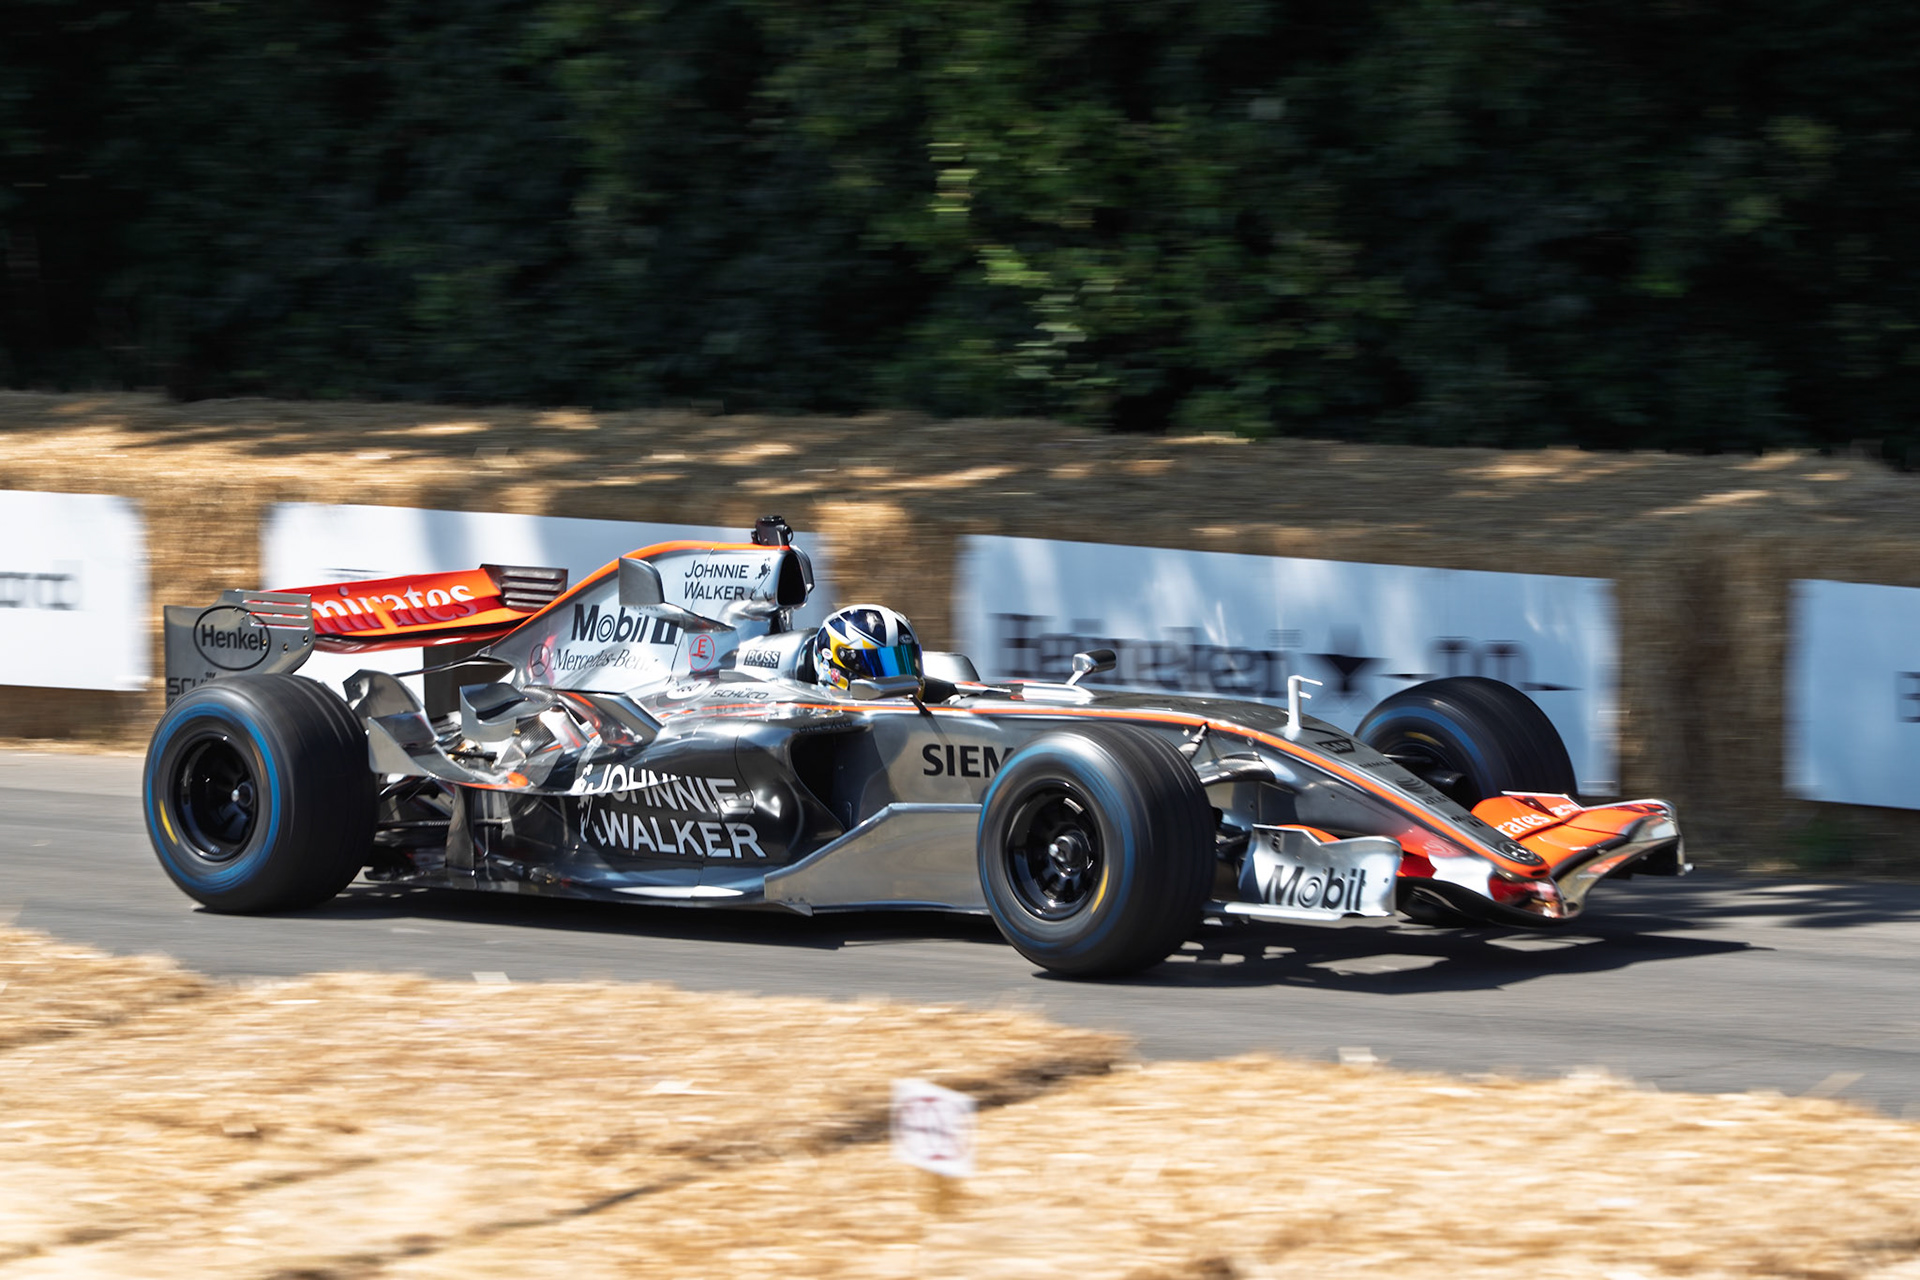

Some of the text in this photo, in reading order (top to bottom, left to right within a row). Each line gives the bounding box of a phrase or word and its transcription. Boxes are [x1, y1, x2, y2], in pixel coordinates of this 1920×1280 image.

[684, 560, 749, 579] JOHNNIE
[684, 582, 745, 601] WALKER
[311, 585, 478, 634] mirates
[571, 603, 650, 643] Mobil
[201, 624, 263, 651] Henkel
[553, 648, 651, 672] Mercedes-Ben
[747, 651, 779, 664] BOSS
[922, 744, 1015, 778] SIEM
[595, 764, 755, 815] JOHNNIE
[600, 808, 767, 859] WALKER
[1494, 813, 1551, 838] rates
[1263, 865, 1366, 911] Mobil
